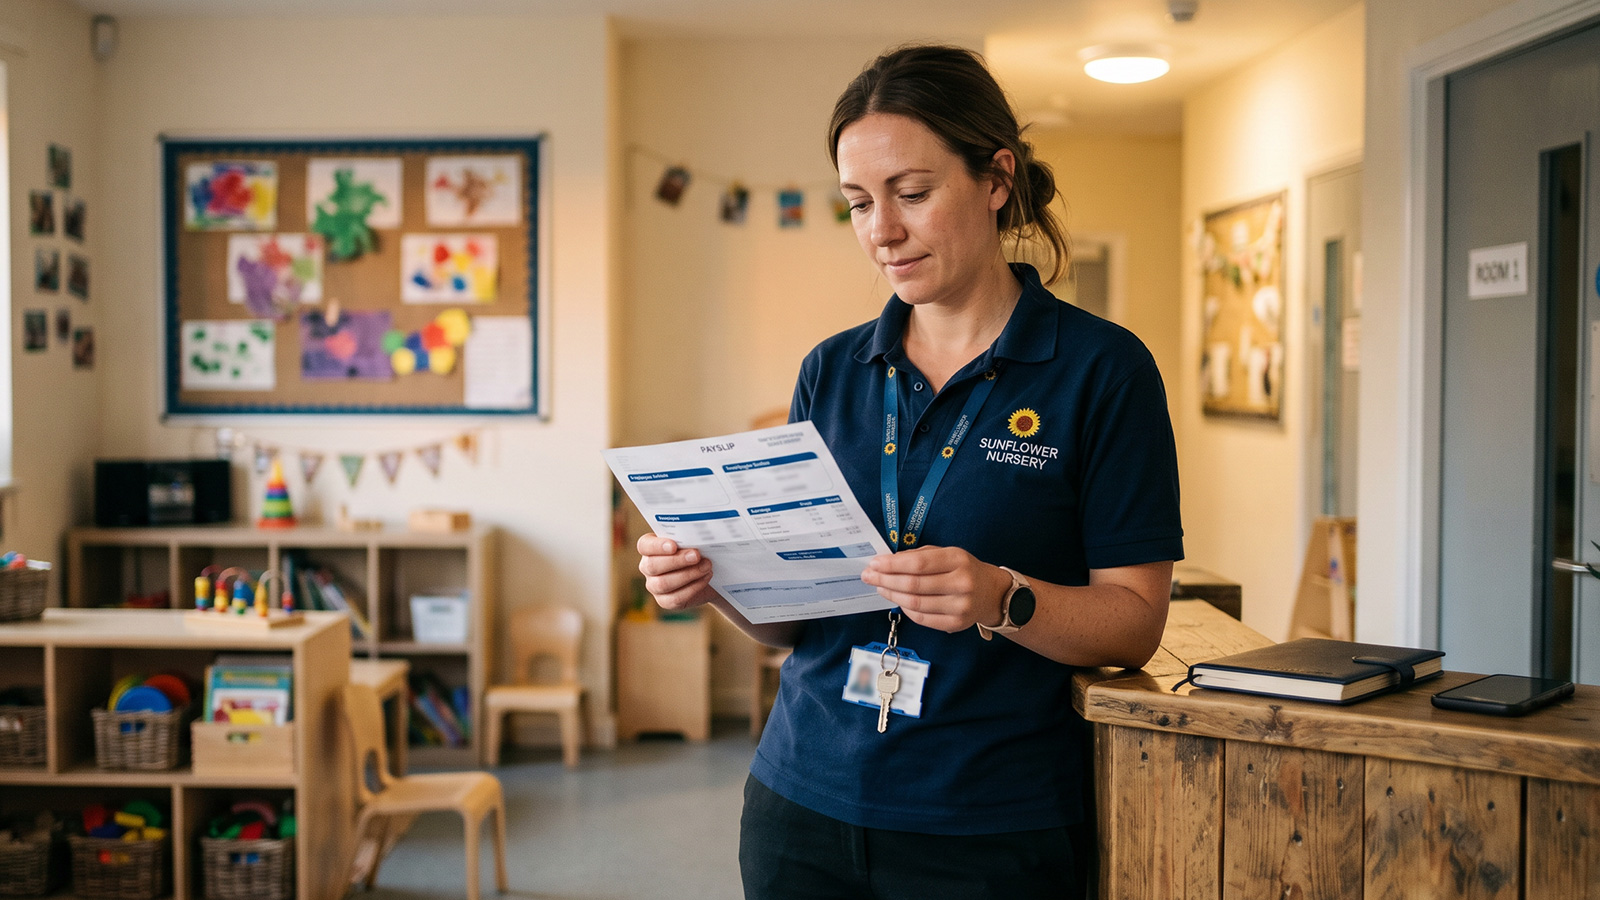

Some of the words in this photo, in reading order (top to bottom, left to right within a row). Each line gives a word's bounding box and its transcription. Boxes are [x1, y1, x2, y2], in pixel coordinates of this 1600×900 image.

[1476, 261, 1509, 283] ROOM
[700, 442, 735, 454] PAYSLIP
[979, 437, 1059, 459] SUNFLOWER
[986, 450, 1047, 470] NURSERY
